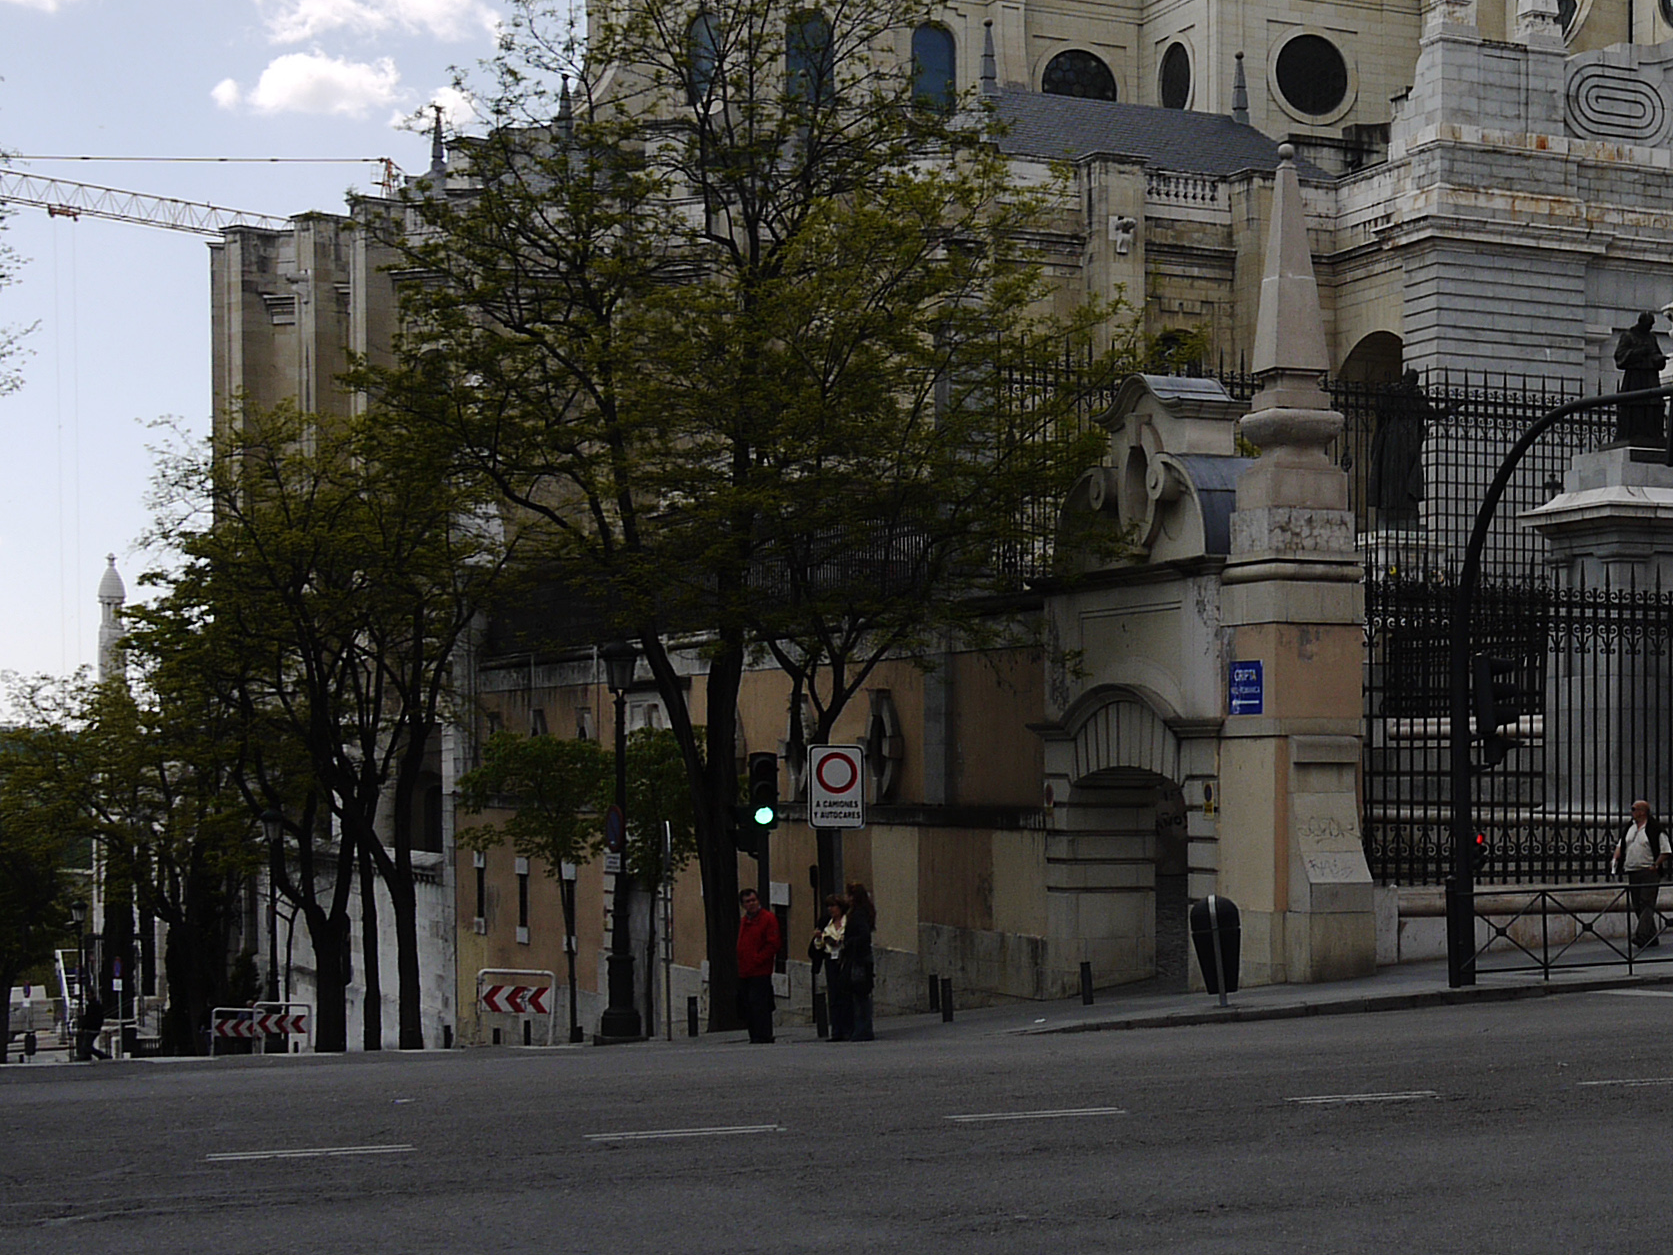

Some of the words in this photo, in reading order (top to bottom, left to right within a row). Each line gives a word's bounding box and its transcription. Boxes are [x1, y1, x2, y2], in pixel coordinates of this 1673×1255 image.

[1234, 669, 1257, 681] CRIPTA
[823, 800, 858, 808] CAMIONES
[821, 811, 860, 819] AUTOCARES
